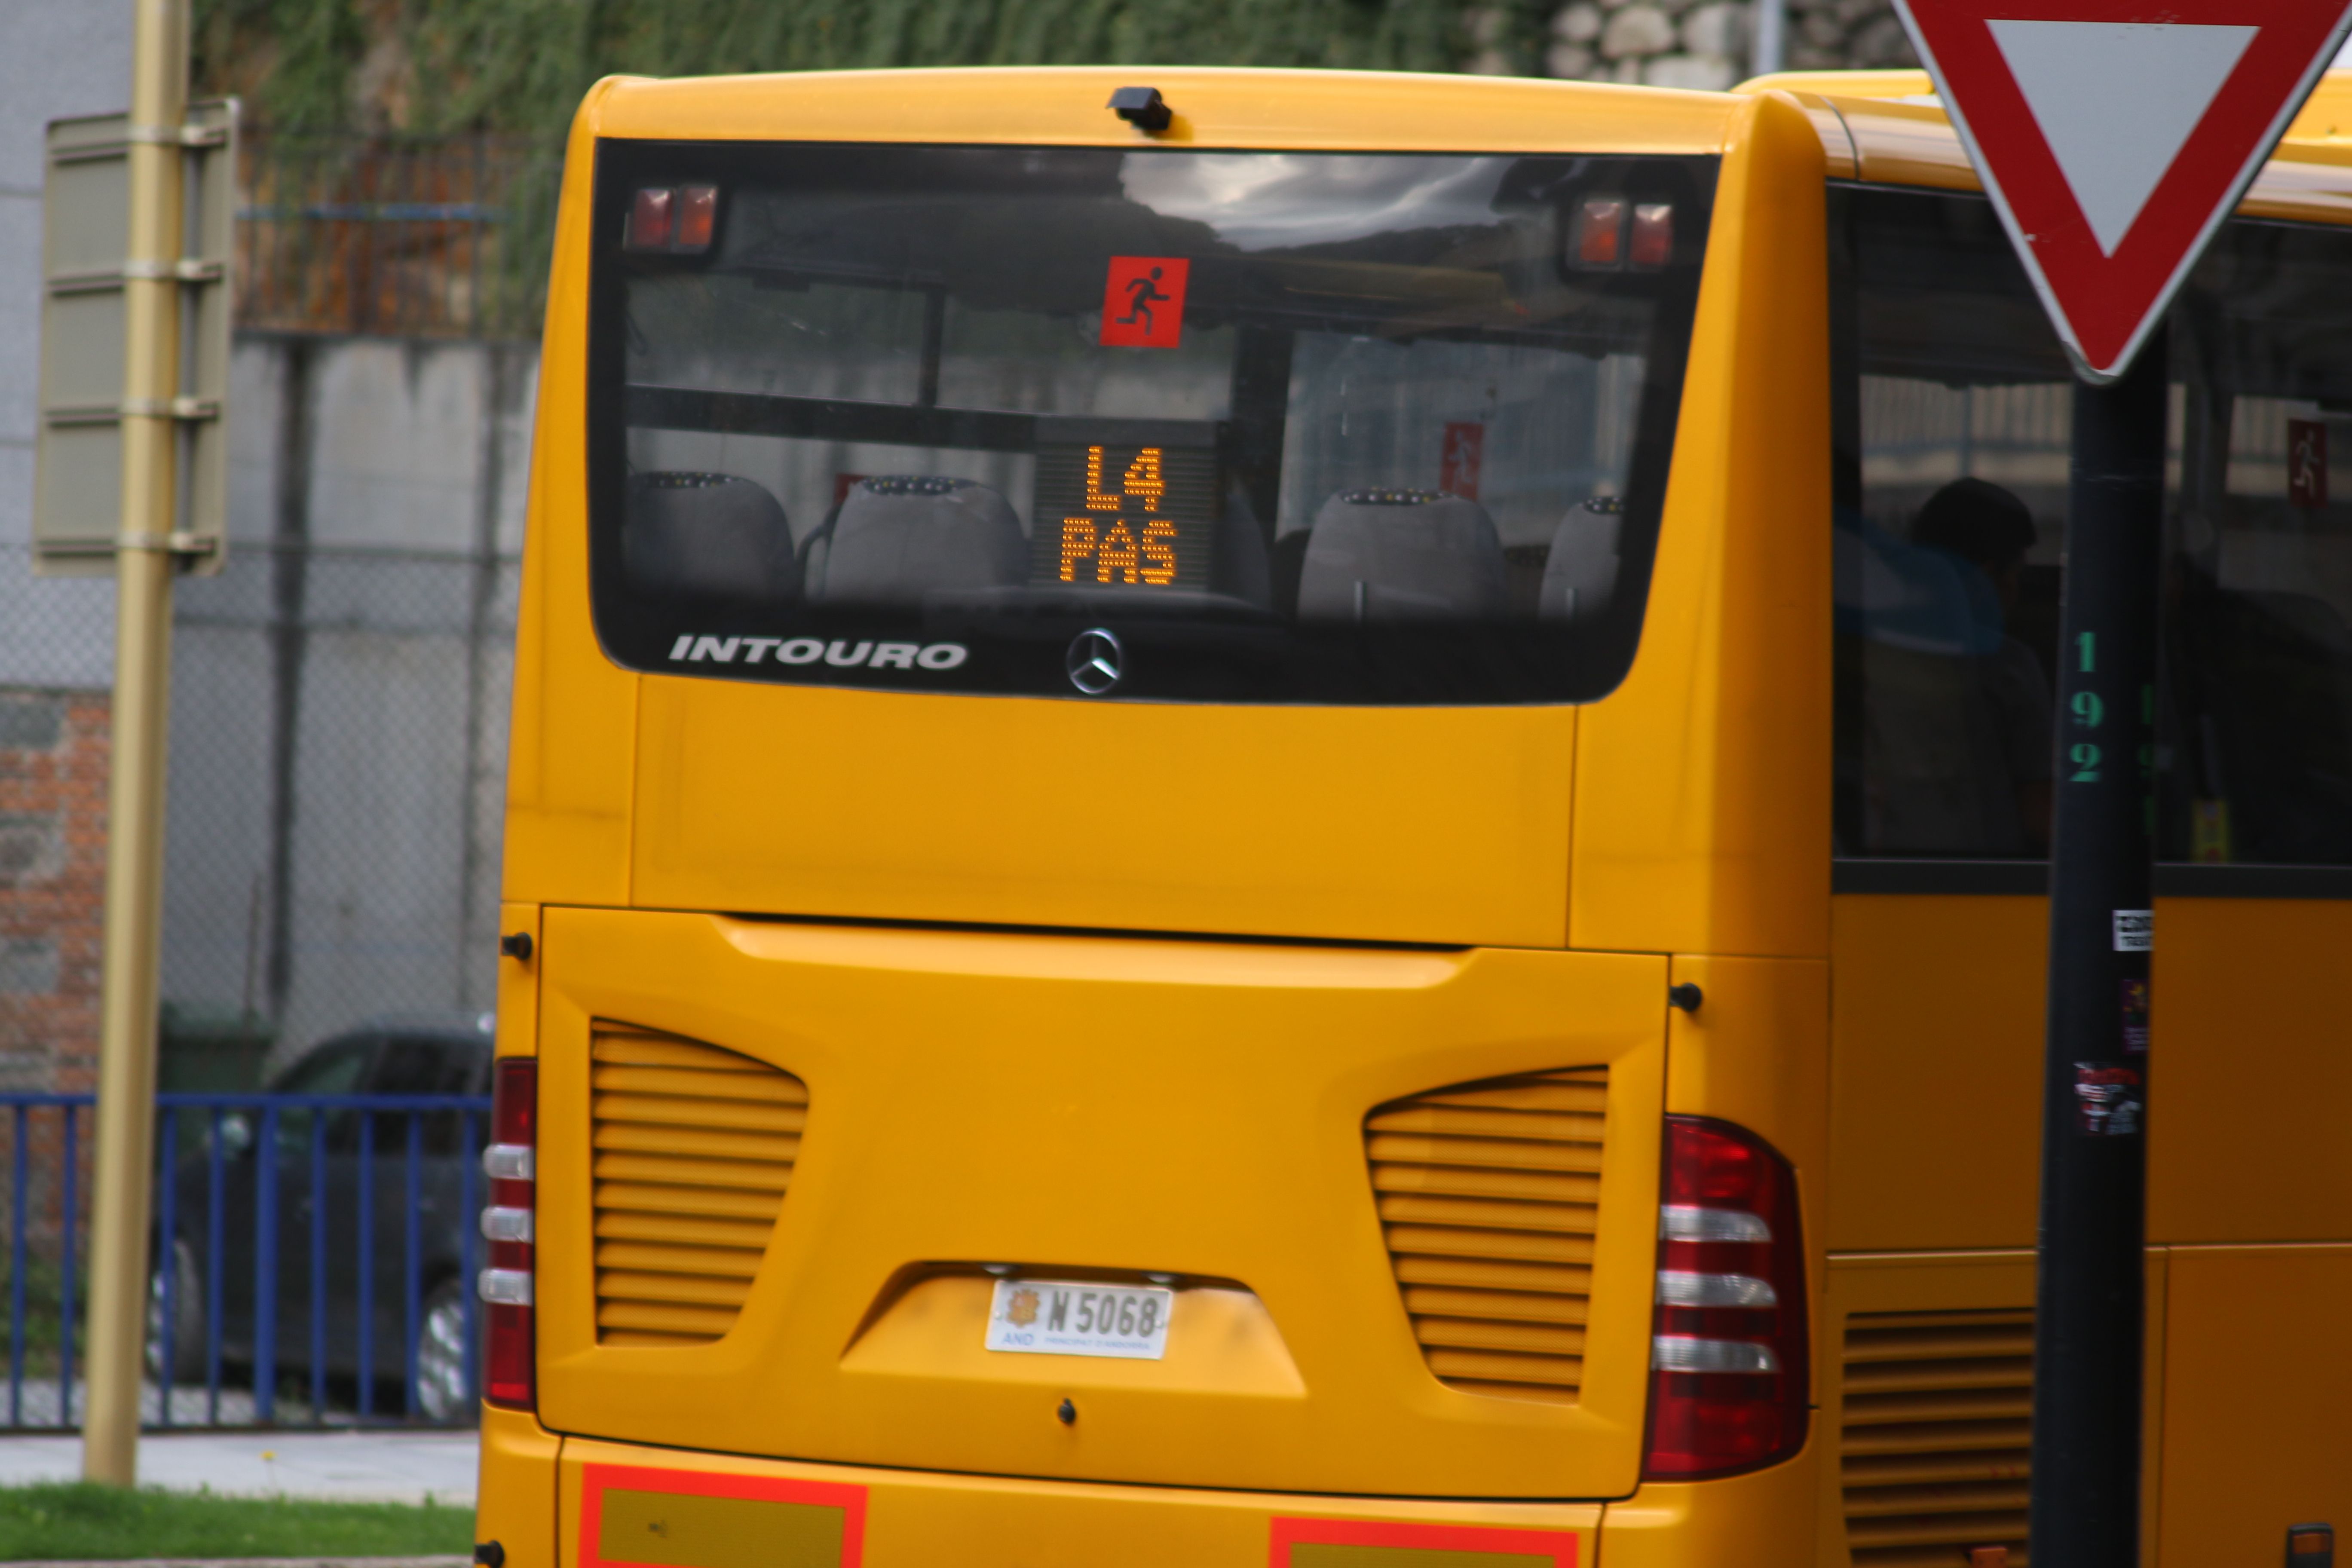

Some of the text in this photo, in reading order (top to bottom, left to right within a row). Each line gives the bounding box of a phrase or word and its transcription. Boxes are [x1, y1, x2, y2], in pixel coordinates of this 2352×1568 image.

[1086, 446, 1165, 511] L4
[1060, 517, 1178, 585] PAS
[669, 634, 968, 670] INTOURO
[2068, 631, 2104, 782] 192
[1002, 1332, 1034, 1346] AND
